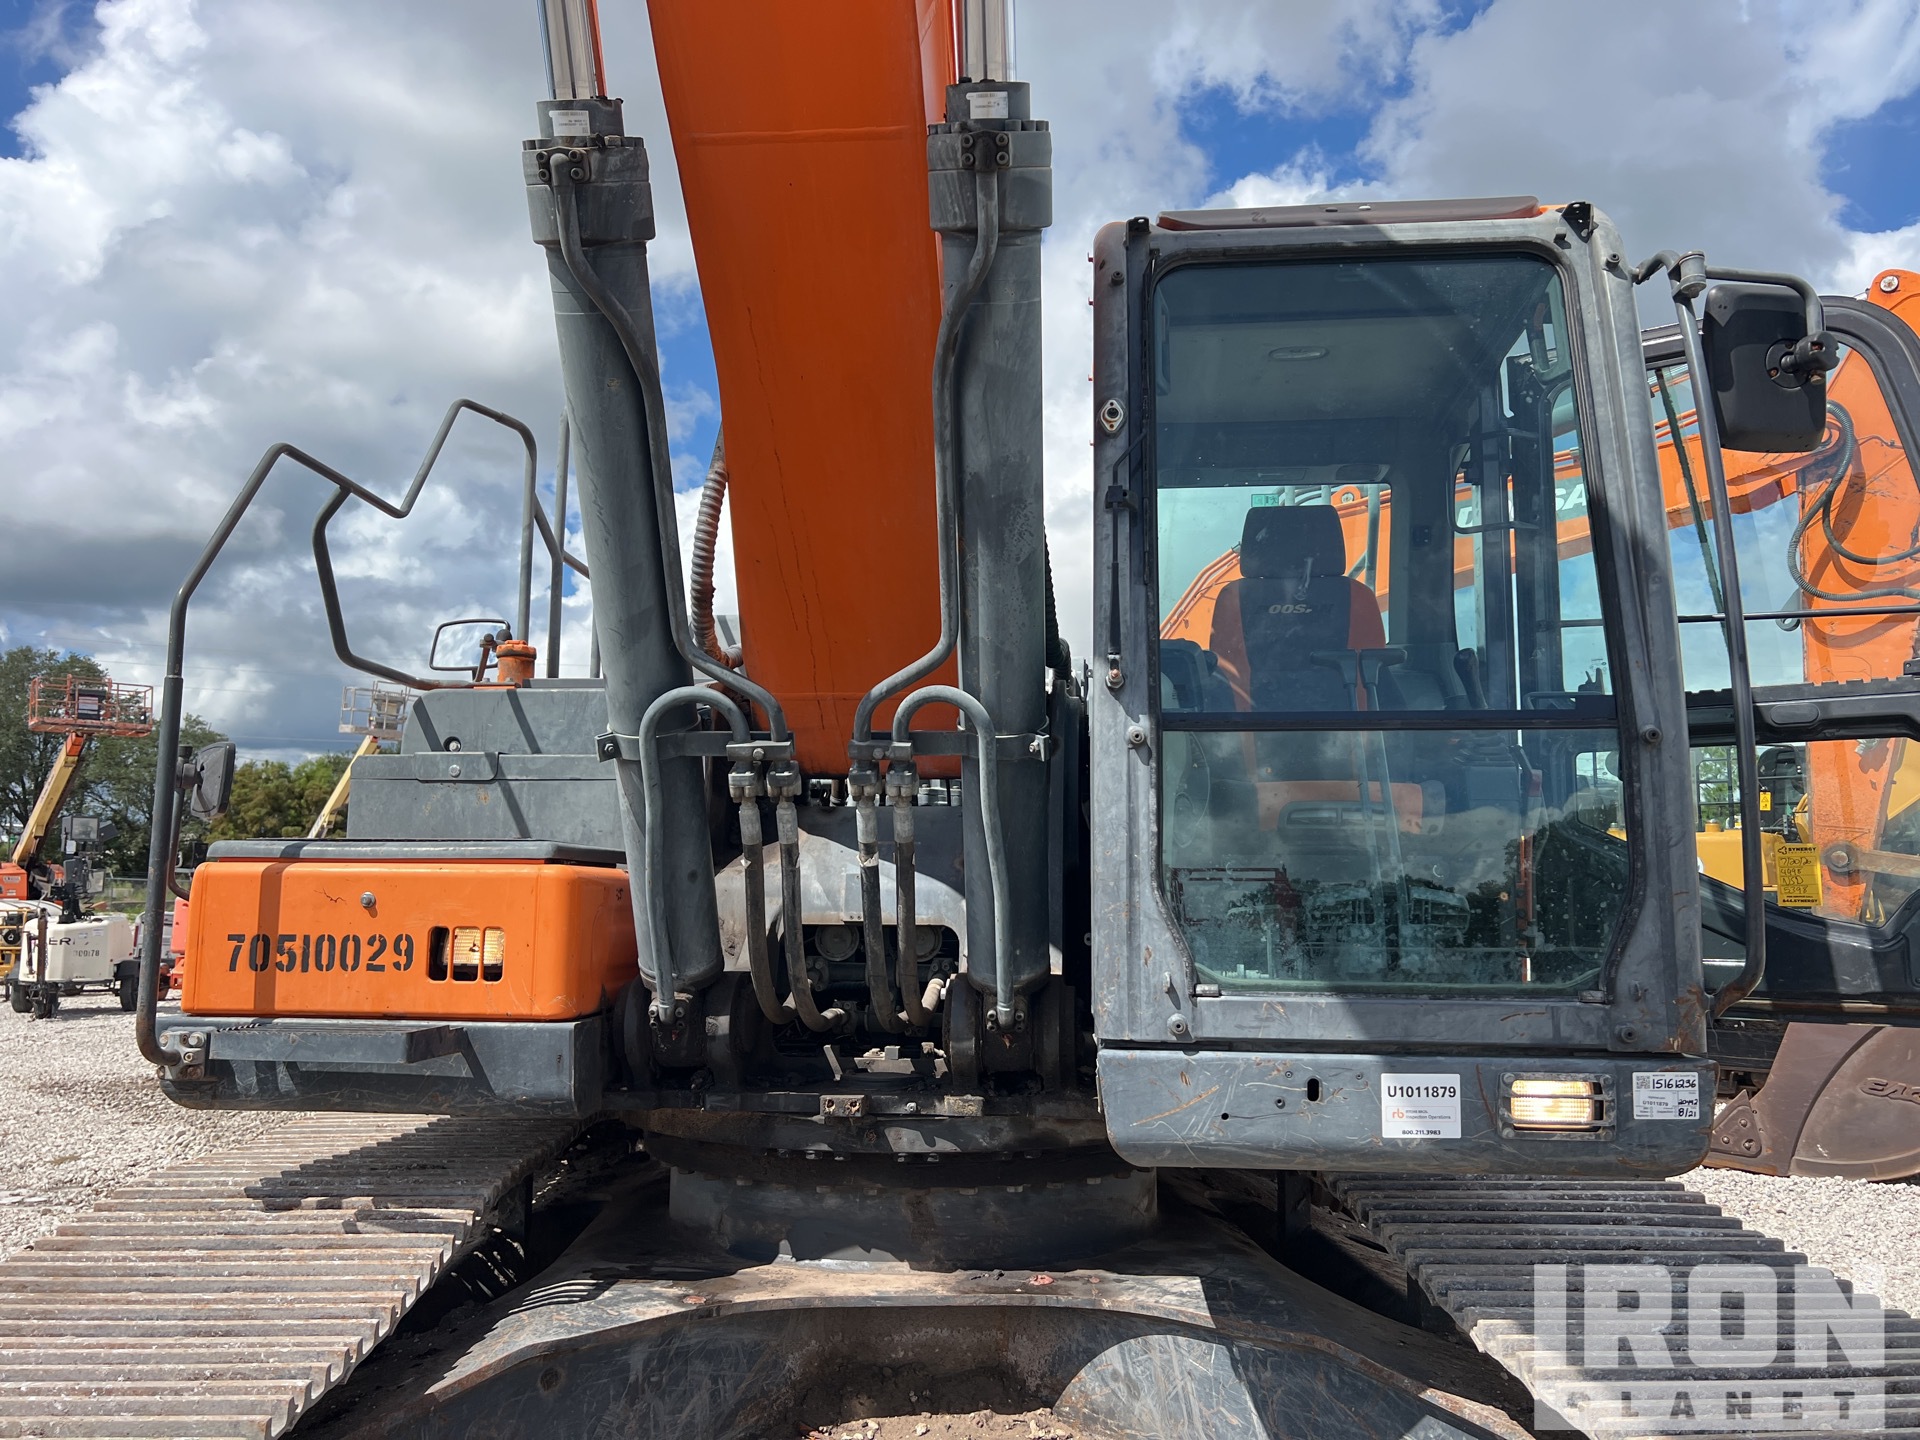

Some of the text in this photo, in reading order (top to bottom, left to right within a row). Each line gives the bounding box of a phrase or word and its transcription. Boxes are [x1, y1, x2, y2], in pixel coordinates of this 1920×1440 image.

[227, 933, 414, 973] 70510029
[1387, 1085, 1456, 1098] U1011879
[1392, 1108, 1405, 1119] rb
[1678, 1107, 1697, 1118] 8/21
